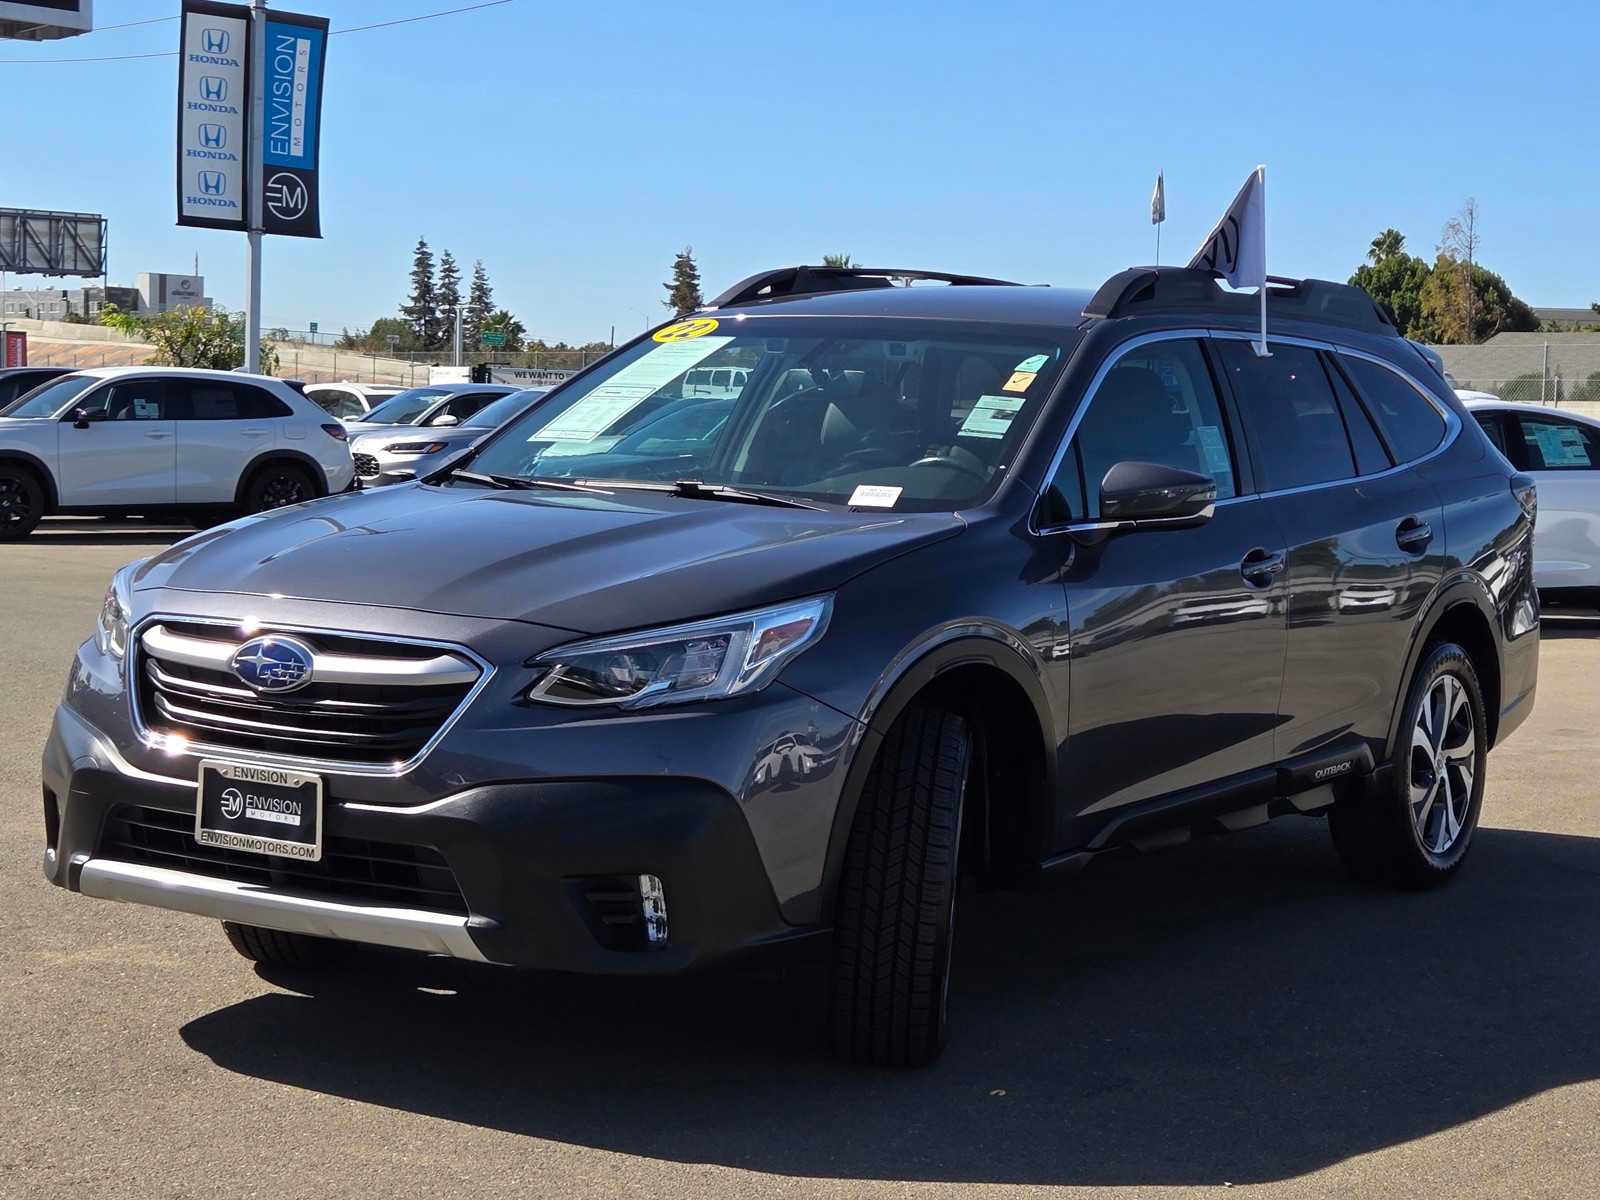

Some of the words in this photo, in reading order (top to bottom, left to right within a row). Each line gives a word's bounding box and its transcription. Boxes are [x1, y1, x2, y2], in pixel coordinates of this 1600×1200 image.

[189, 54, 240, 67] HONDA
[271, 35, 296, 156] ENVISION
[294, 49, 307, 147] MOTORS
[187, 102, 239, 114] HONDA
[186, 149, 238, 161] HONDA
[186, 196, 238, 208] HONDA
[233, 766, 288, 784] ENVISION
[1315, 761, 1351, 778] OUTBACK
[246, 794, 301, 815] ENVISION
[201, 831, 315, 859] ENVISIONMOTORS.COM
